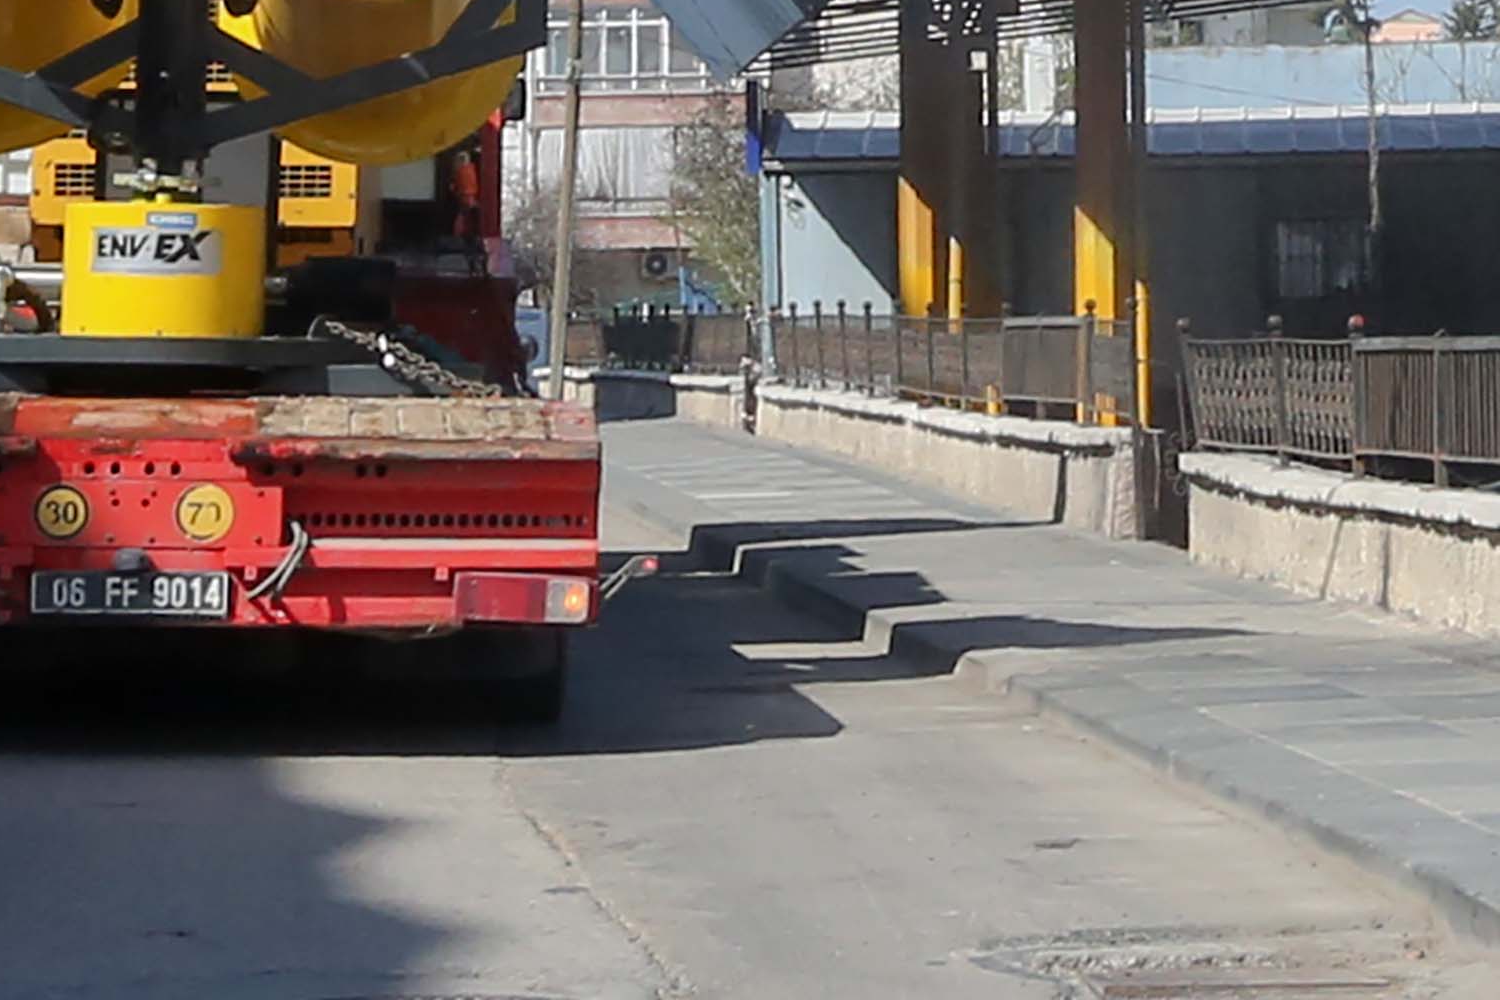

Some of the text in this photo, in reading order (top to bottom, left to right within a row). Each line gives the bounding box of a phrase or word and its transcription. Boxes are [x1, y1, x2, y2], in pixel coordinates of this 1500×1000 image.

[46, 500, 78, 525] 30
[53, 577, 221, 608] 06 FF 9014
